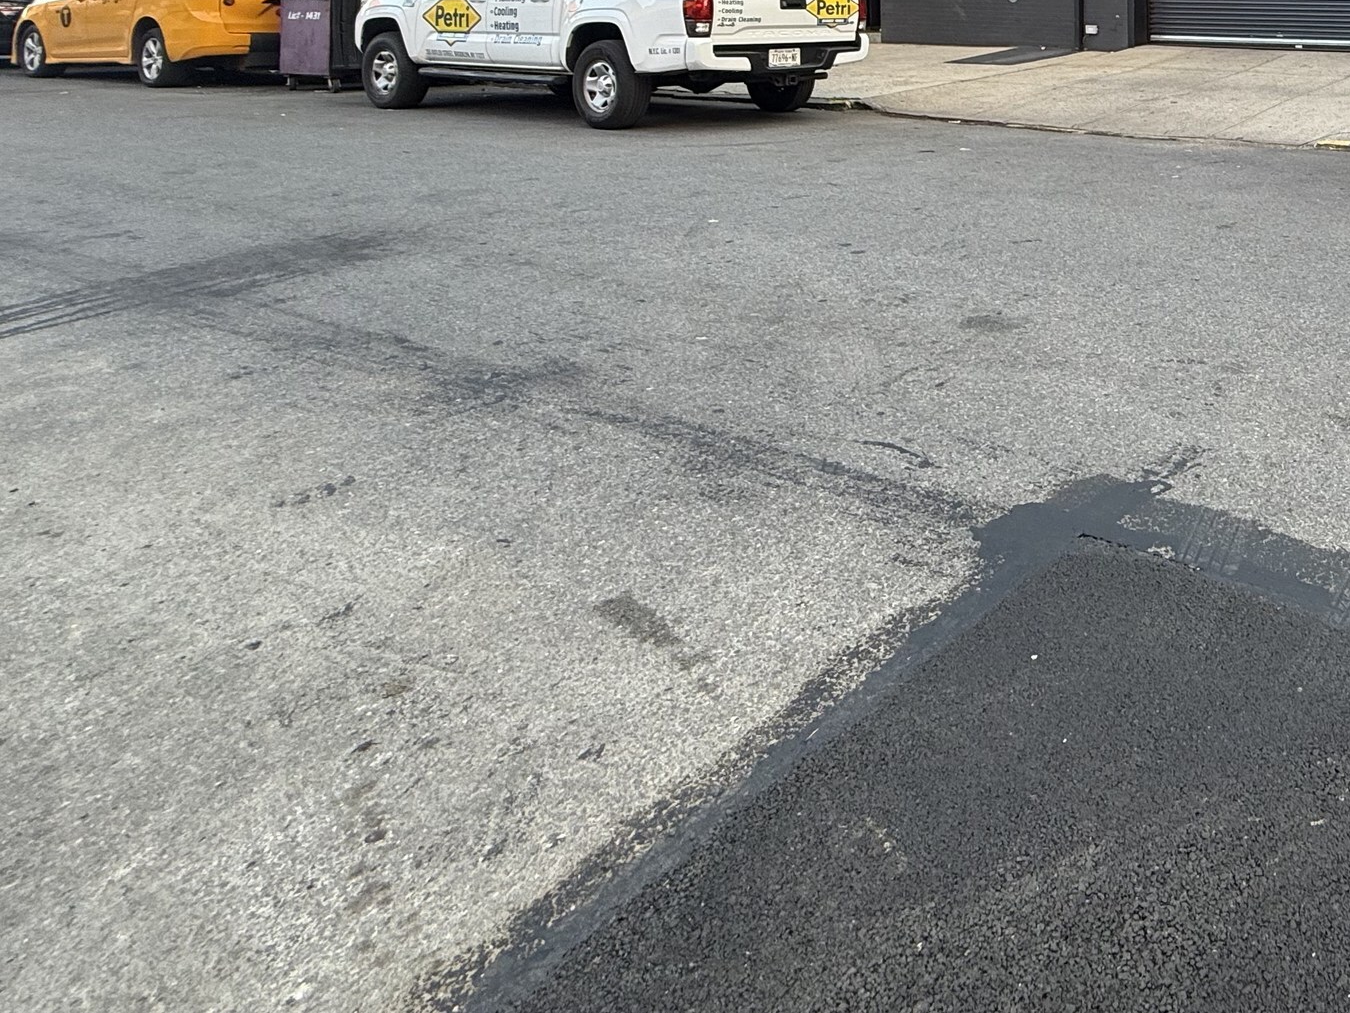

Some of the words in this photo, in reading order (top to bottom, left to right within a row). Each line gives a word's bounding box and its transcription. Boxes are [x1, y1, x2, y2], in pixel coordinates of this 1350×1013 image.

[494, 7, 518, 17] Cooling
[816, 0, 851, 16] Petri
[435, 5, 469, 28] Petri
[738, 16, 762, 24] Cleaning
[494, 21, 520, 32] Heating
